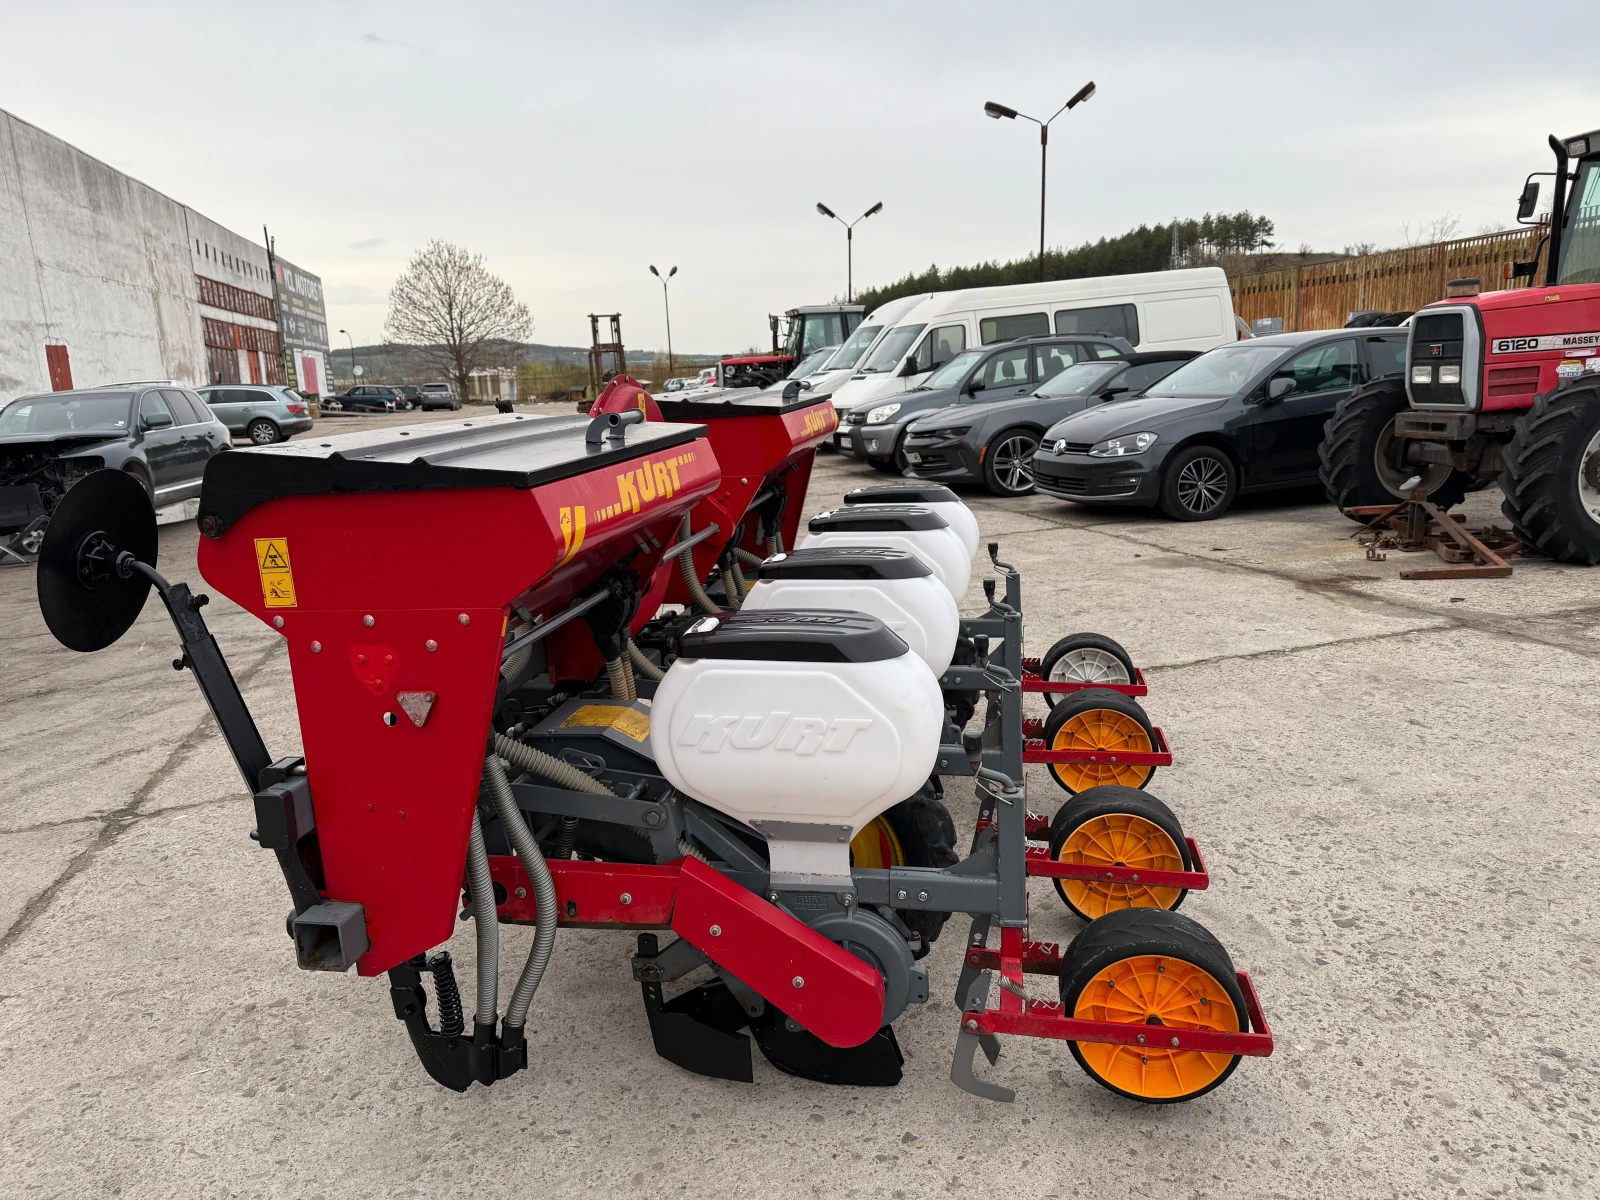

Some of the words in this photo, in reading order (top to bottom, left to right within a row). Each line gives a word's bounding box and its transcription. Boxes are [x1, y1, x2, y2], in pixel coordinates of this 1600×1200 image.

[295, 273, 318, 301] MOTORS
[1498, 338, 1539, 352] 6120
[1562, 335, 1600, 346] MASSEY
[803, 409, 826, 437] KURT
[616, 460, 681, 514] KURT
[677, 711, 873, 756] KURT
